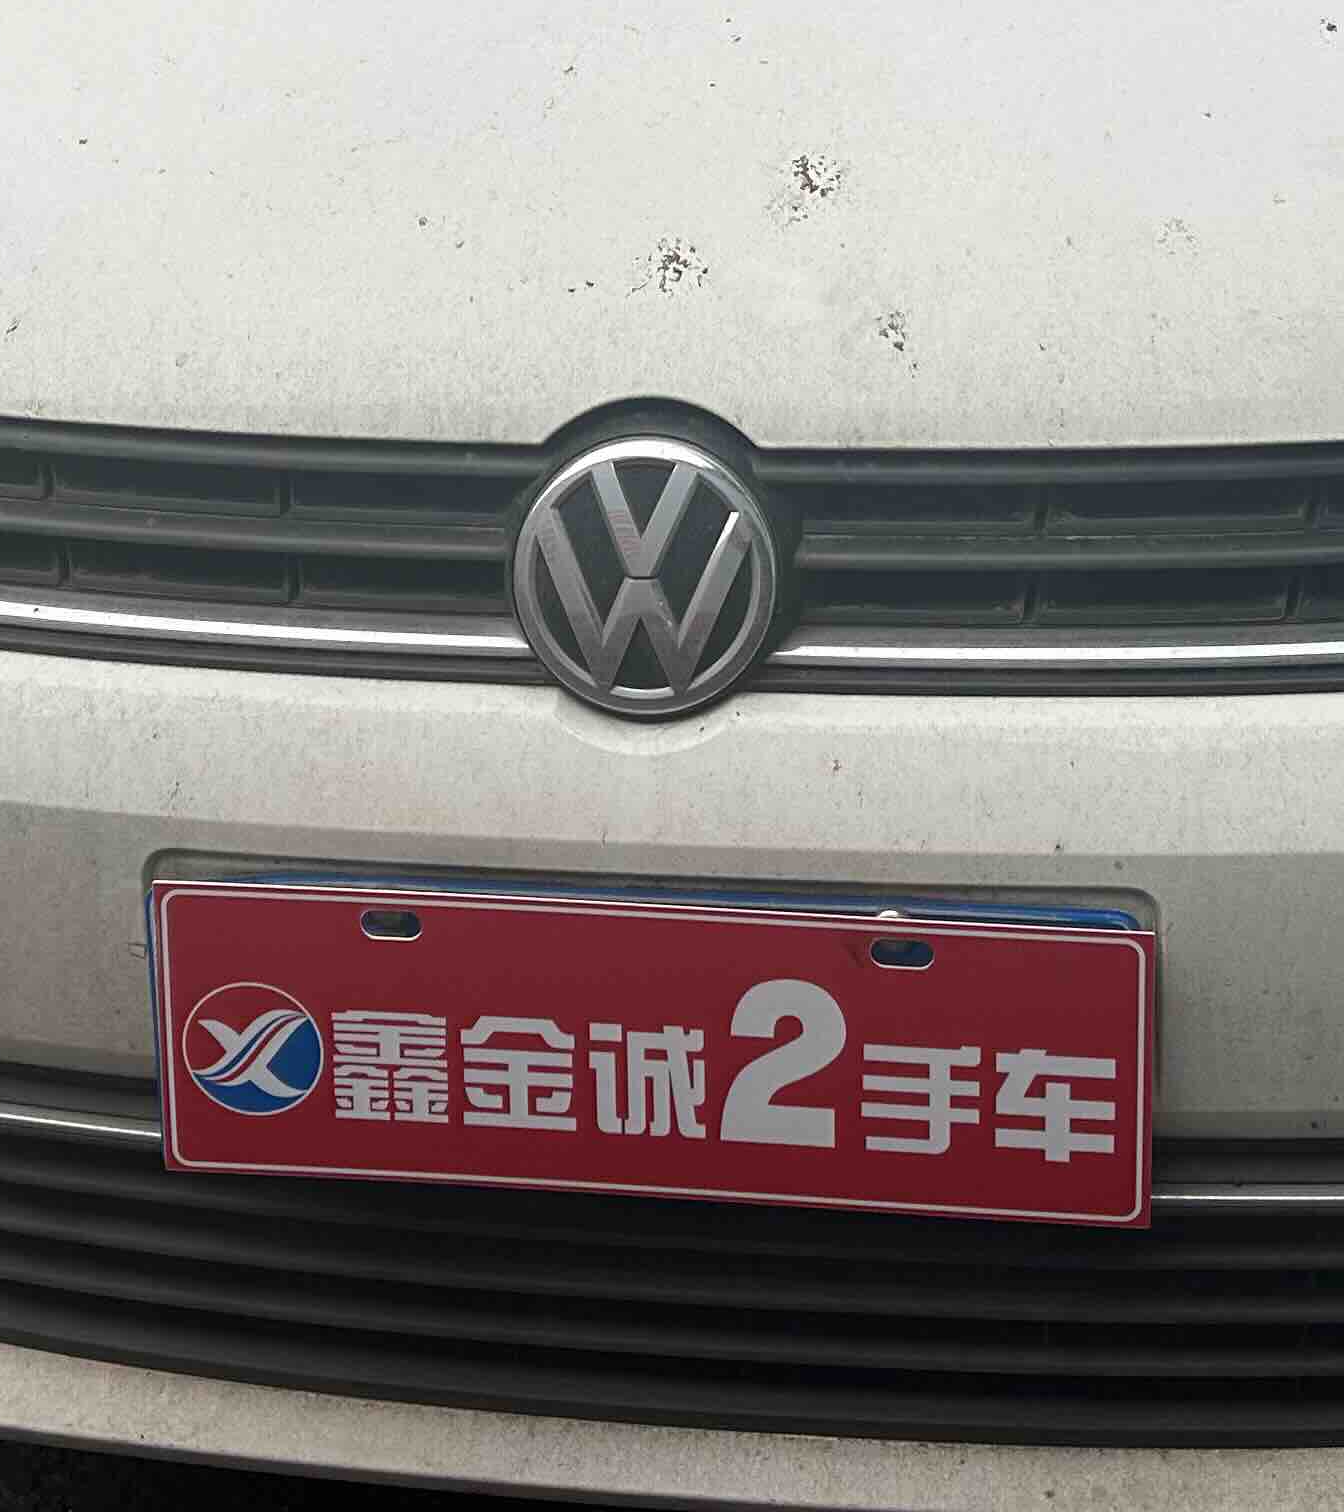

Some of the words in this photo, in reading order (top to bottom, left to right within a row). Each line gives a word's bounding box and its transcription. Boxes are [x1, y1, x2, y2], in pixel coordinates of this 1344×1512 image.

[330, 977, 1117, 1164] 鑫金诚2手车
